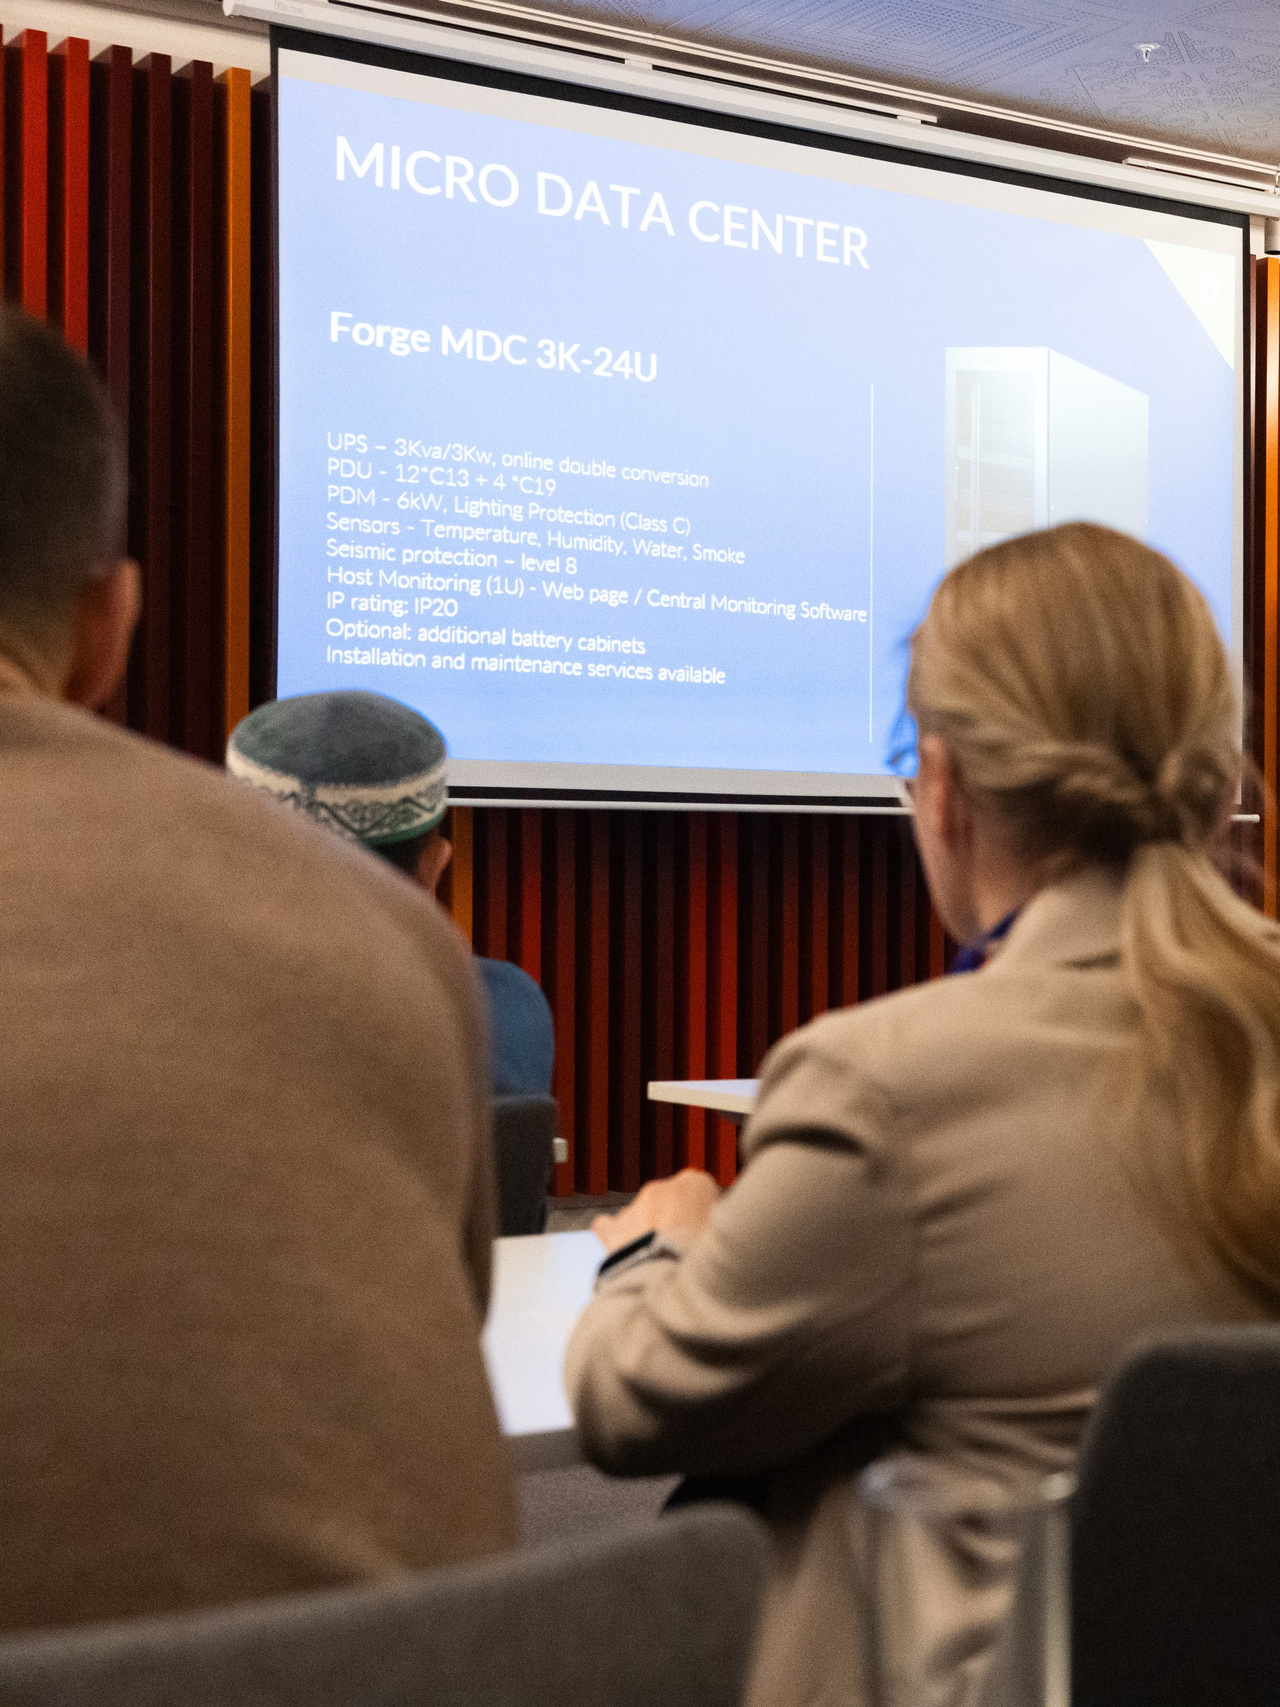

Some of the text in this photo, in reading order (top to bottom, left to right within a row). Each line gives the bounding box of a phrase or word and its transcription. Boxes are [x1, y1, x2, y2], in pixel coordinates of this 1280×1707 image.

[336, 135, 870, 269] MICRO DATA CENTER
[330, 310, 658, 383] Forge MDC 3K-24U
[326, 431, 368, 453] UPS
[393, 438, 497, 467] 3Kva/3Kw,
[501, 451, 554, 471] online
[558, 456, 617, 479] double
[621, 465, 710, 488] conversion
[326, 457, 372, 479] PDU
[475, 474, 488, 487] +
[492, 473, 506, 491] 4
[326, 485, 376, 506] PDM
[396, 491, 448, 515] 6kW,
[453, 495, 524, 522] Lighting
[528, 502, 616, 528] Protection
[620, 511, 668, 533] (Class
[672, 517, 692, 537] C)
[325, 511, 401, 535] Sensors
[420, 519, 542, 548] Temperature,
[547, 529, 628, 557] Humidity,
[632, 538, 688, 561] Water,
[692, 544, 746, 565] Smoke
[325, 538, 397, 561] Seismic
[401, 547, 498, 569] protection
[520, 552, 560, 573] level
[565, 556, 578, 574] 8
[326, 566, 374, 587] Host
[378, 568, 482, 597] Monitoring
[485, 575, 525, 598] (1U)
[542, 580, 585, 601] Web
[588, 587, 629, 608] page
[633, 588, 643, 606] /
[646, 588, 707, 611] Central
[710, 593, 797, 621] Monitoring
[799, 601, 868, 623] Software
[326, 591, 459, 618] IP rating: IP20
[325, 617, 647, 656] Optional: additional battery cabinets
[326, 644, 727, 685] Installation and maintenance services available
